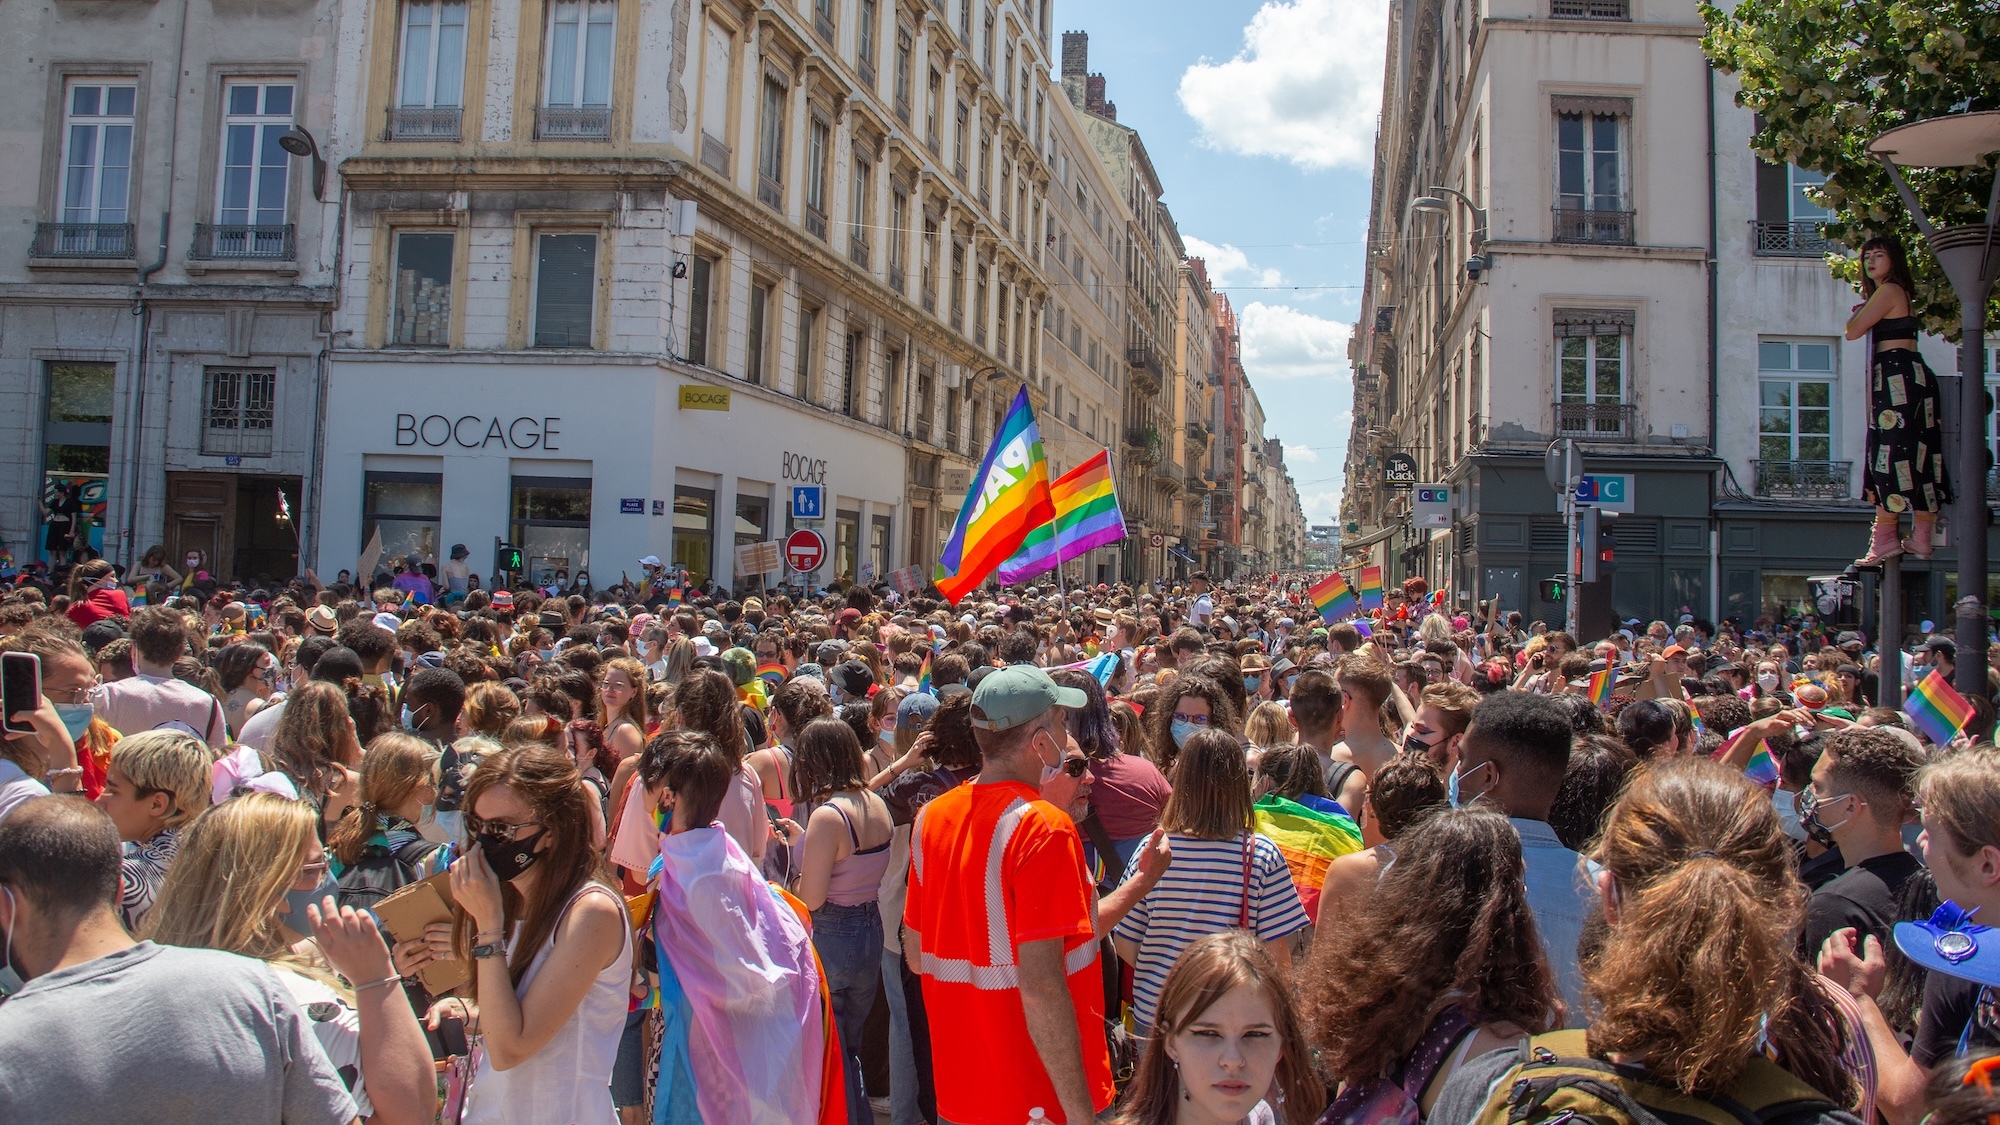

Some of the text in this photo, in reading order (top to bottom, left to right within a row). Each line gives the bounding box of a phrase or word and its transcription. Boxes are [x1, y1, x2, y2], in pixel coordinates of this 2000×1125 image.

[685, 392, 728, 405] BOCAGE
[396, 413, 561, 450] BOCAGE
[782, 451, 828, 486] BOCAGE
[1390, 459, 1409, 472] Tie
[1385, 469, 1416, 481] Rack
[1575, 480, 1619, 498] CIC
[1421, 491, 1445, 501] CIC
